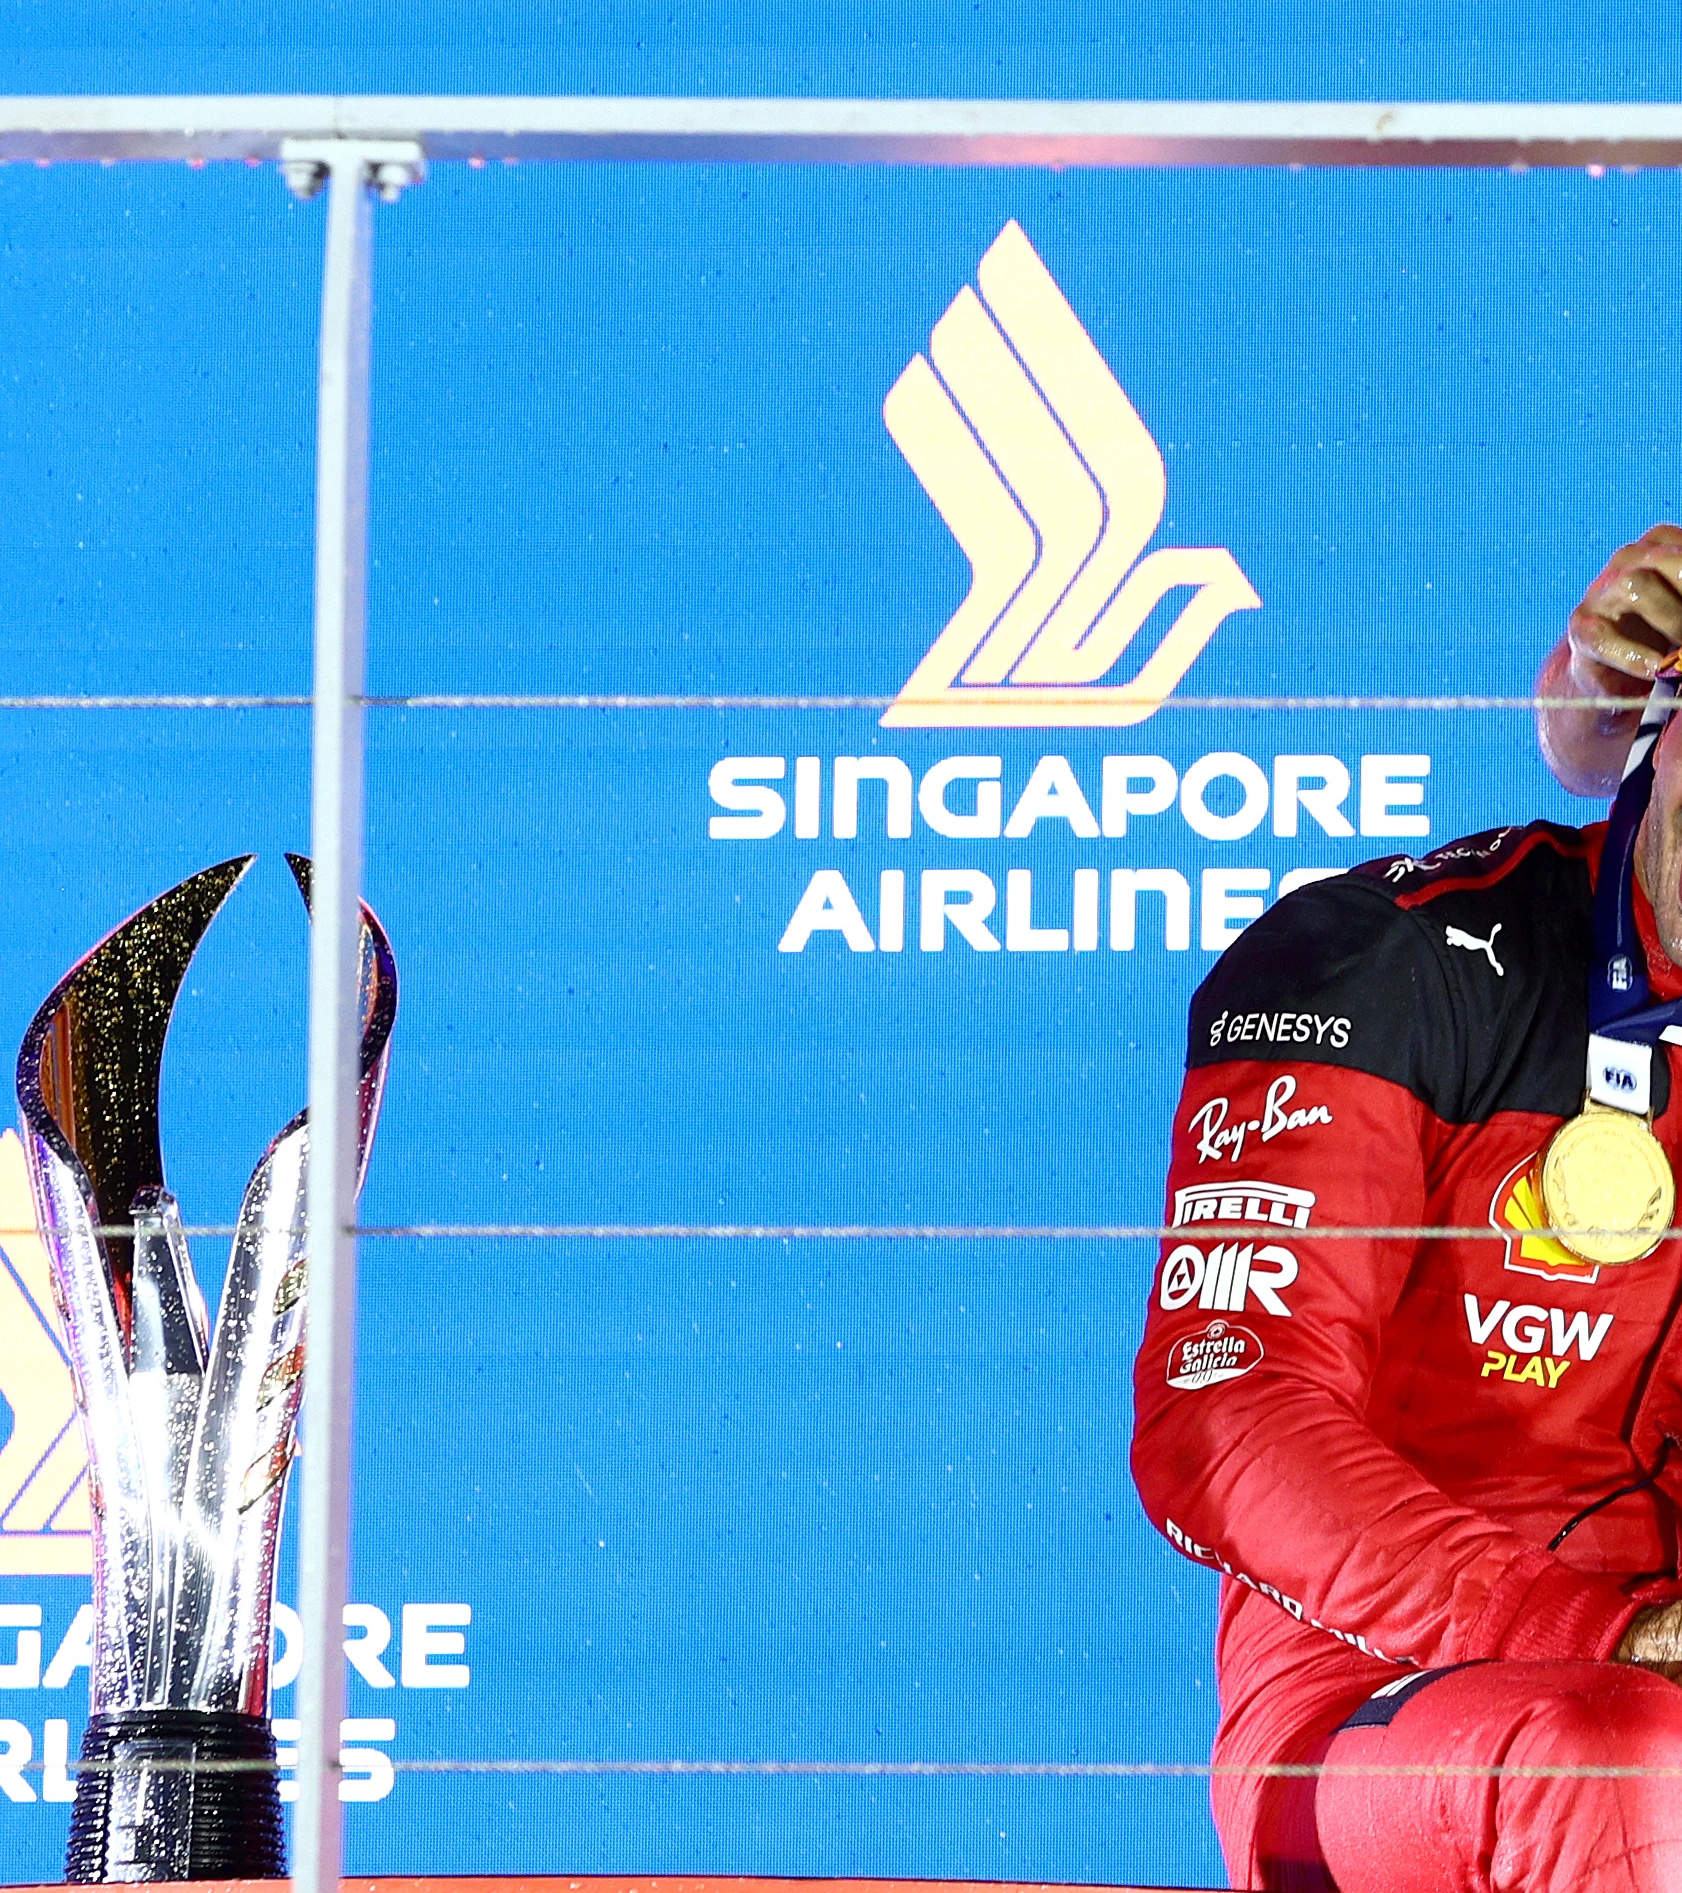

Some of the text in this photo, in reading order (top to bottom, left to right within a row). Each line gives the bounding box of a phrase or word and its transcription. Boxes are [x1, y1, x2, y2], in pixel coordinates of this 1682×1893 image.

[707, 752, 1431, 840] SINGAPORE
[1227, 1012, 1352, 1049] GENESYS
[1604, 1066, 1634, 1090] FIA
[1189, 1074, 1333, 1165] Ray-Ban
[1171, 1180, 1317, 1230] PIRELLI
[1464, 1293, 1615, 1361] VGW
[1179, 1353, 1238, 1374] Galicia
[1182, 1336, 1246, 1361] Estrella
[1481, 1351, 1571, 1389] PLAY
